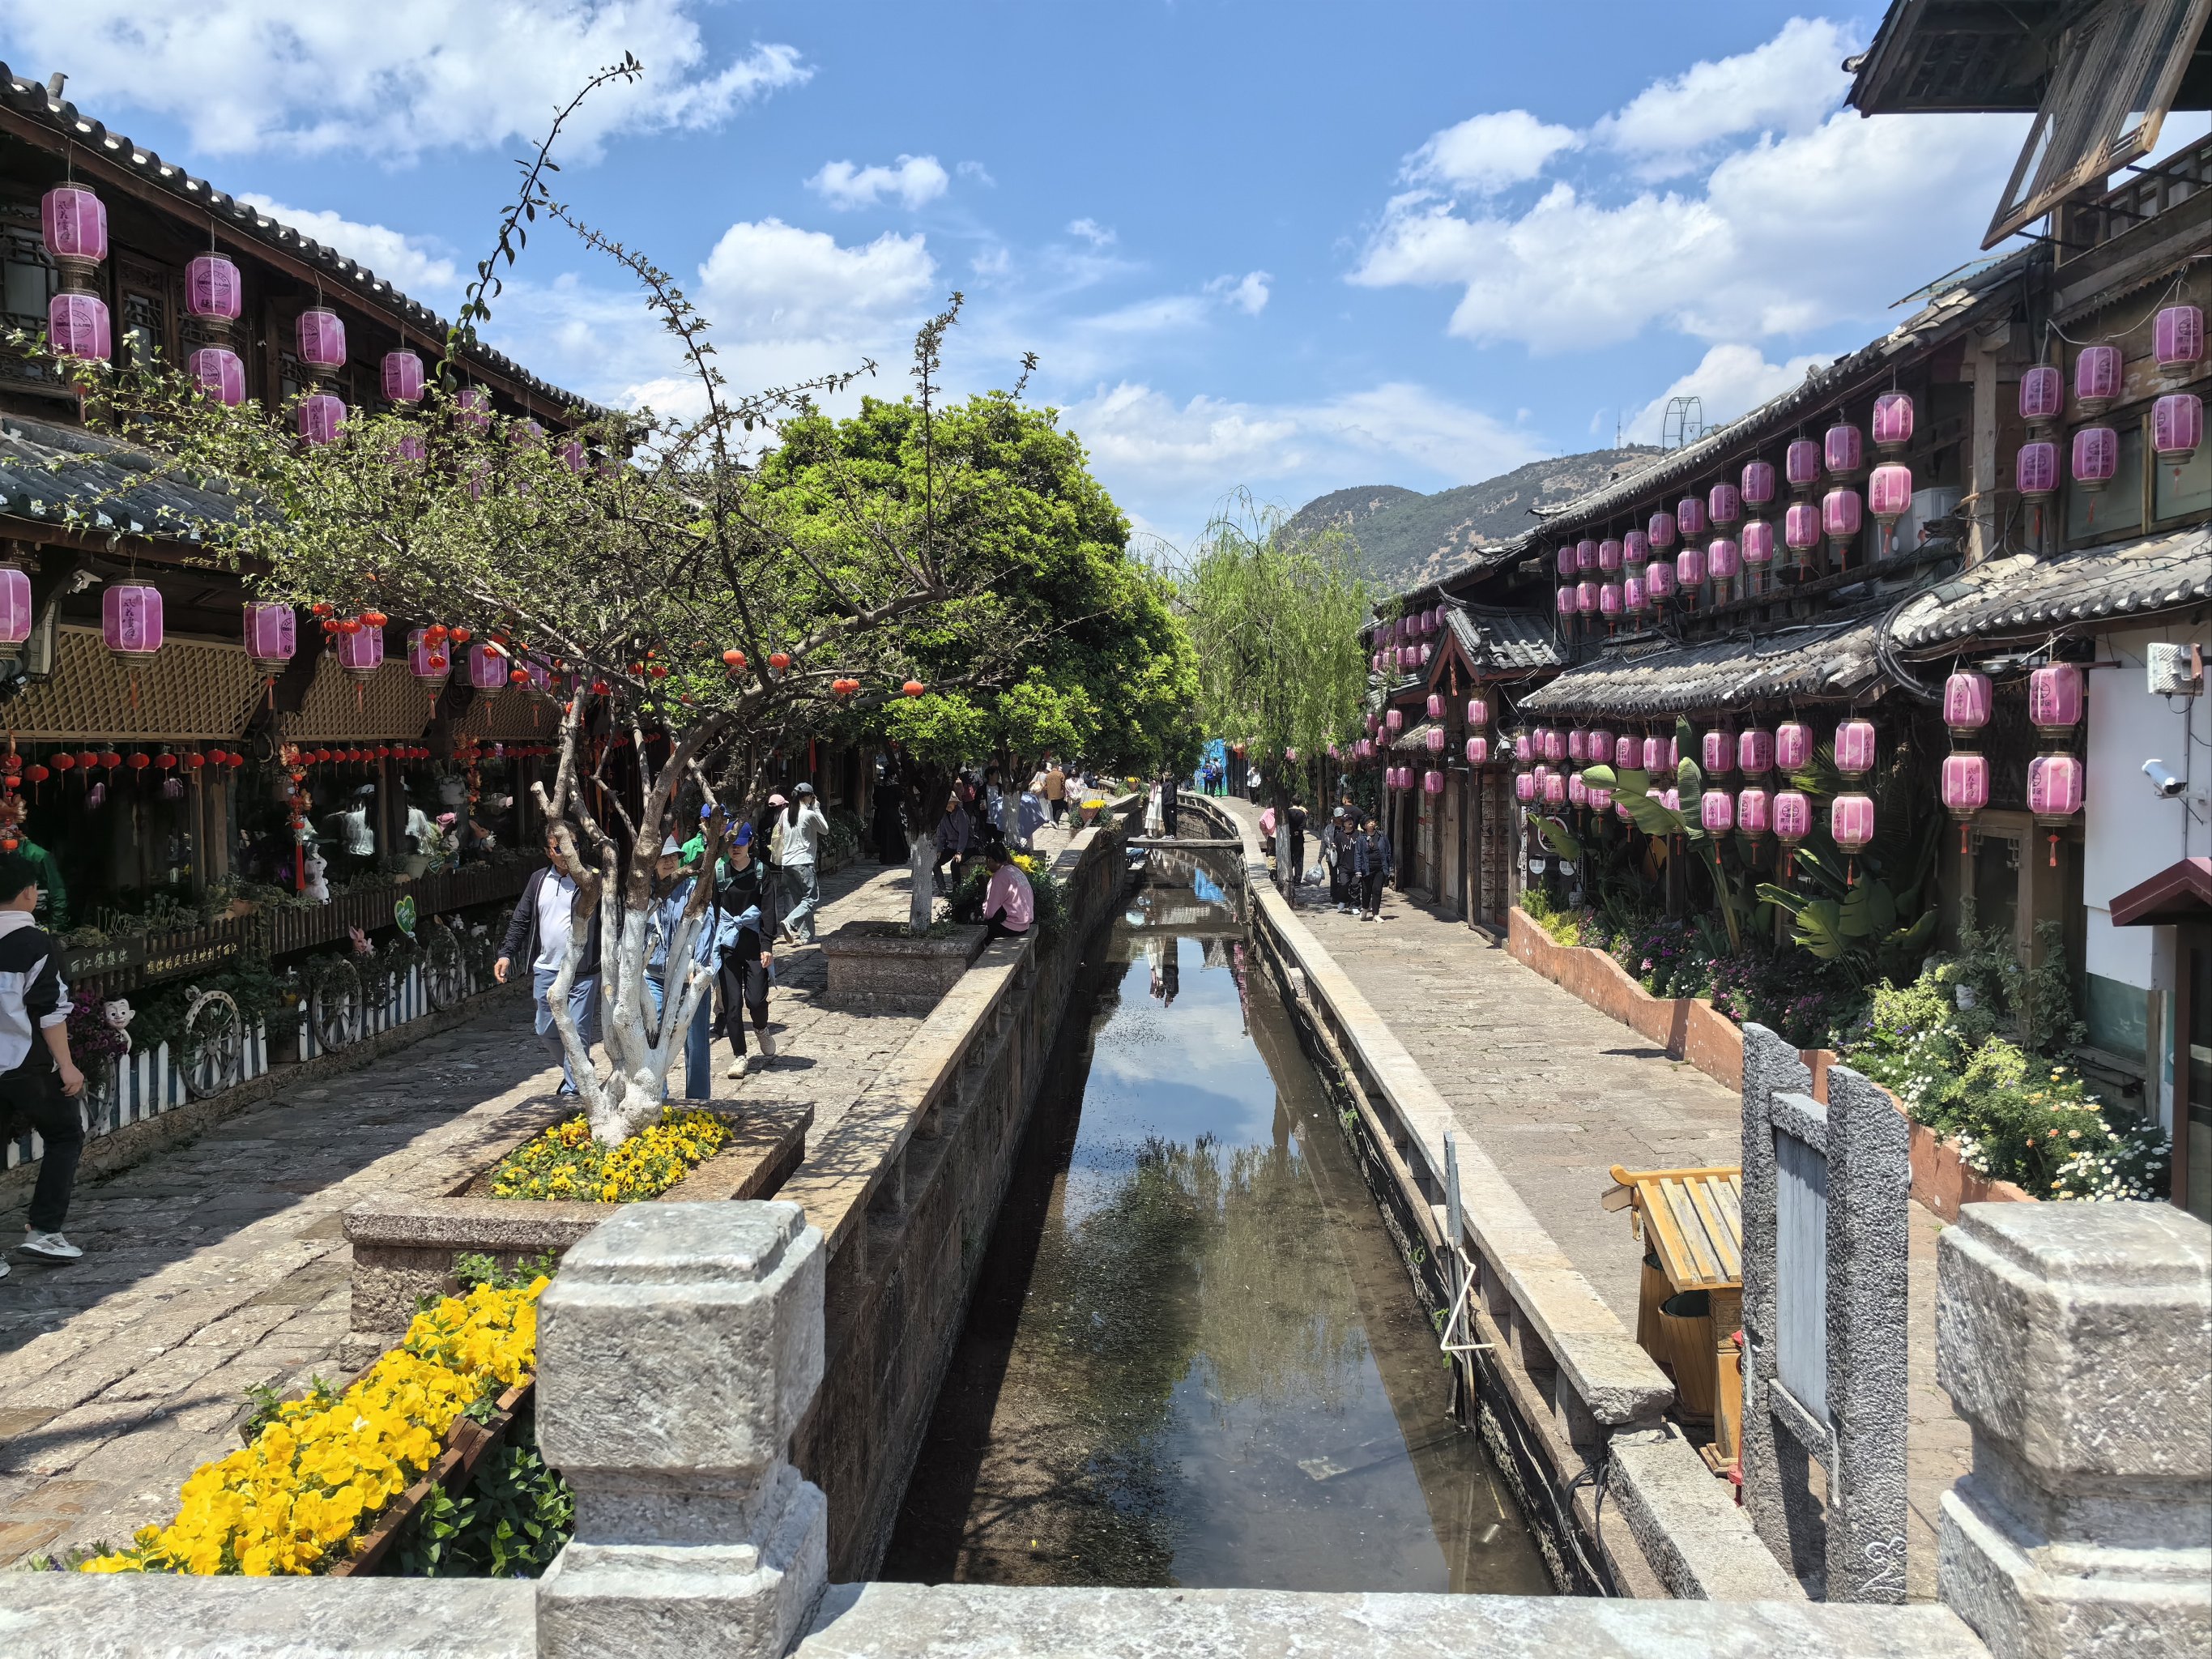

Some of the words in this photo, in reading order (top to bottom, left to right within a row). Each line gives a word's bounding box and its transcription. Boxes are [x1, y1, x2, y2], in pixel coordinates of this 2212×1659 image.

[122, 598, 137, 638] 风花雪月
[71, 949, 127, 972] 丽江很想你
